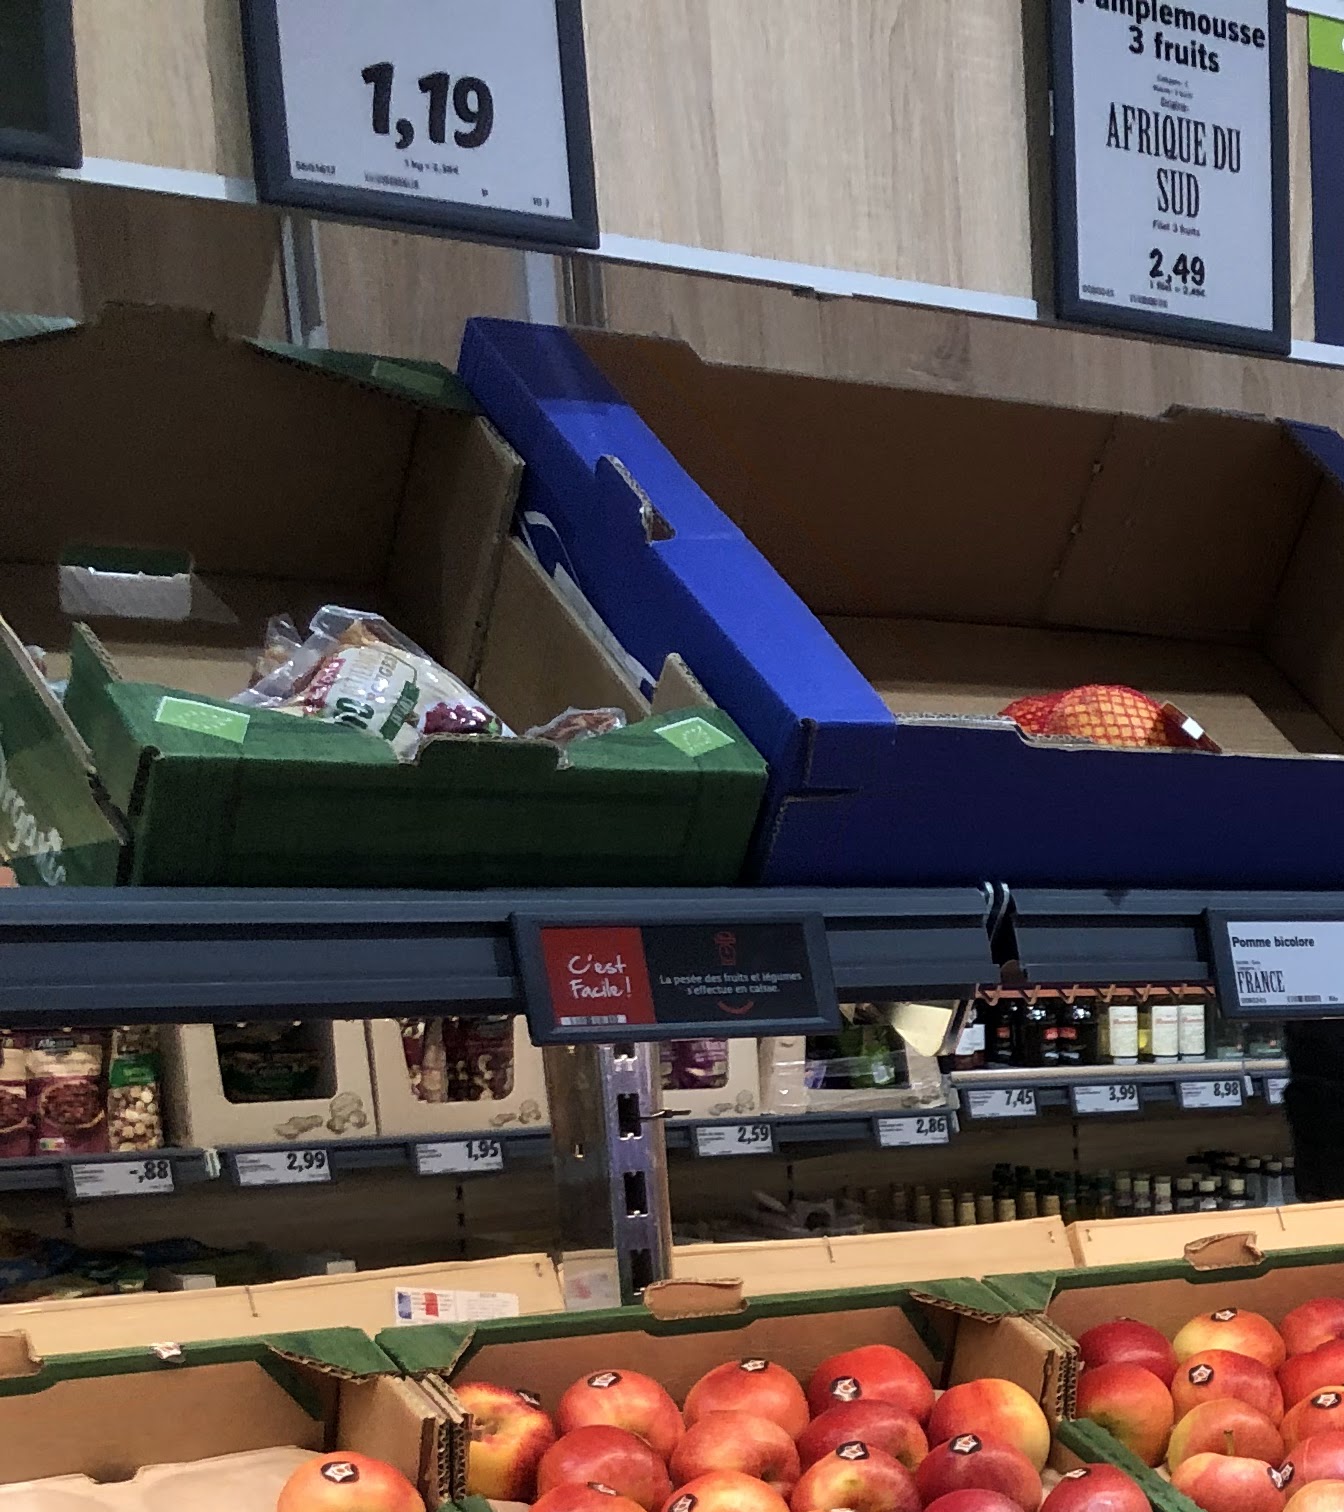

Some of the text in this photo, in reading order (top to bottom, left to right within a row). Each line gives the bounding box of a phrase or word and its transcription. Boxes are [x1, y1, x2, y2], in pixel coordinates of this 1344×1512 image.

[1078, 0, 1266, 49] amplemousse
[1128, 25, 1220, 73] 3 fruits
[361, 61, 495, 150] 1,19
[1106, 101, 1242, 173] AFRIQUE DU
[1157, 168, 1200, 218] SUD
[1149, 247, 1206, 287] 2,49
[1232, 936, 1315, 948] Pomme bicolore
[568, 953, 628, 975] C'est
[660, 974, 672, 985] La
[705, 973, 722, 984] des
[724, 972, 749, 983] fruits
[750, 972, 761, 982] et
[1237, 970, 1286, 994] FRANCE
[1003, 1089, 1034, 1108] 7,45
[1108, 1084, 1137, 1102] 3,99
[1212, 1080, 1241, 1098] 8,98
[736, 1125, 770, 1145] 2,59
[915, 1117, 946, 1136] 2,86
[465, 1140, 500, 1161] 1,95
[287, 1151, 326, 1172] 2,99
